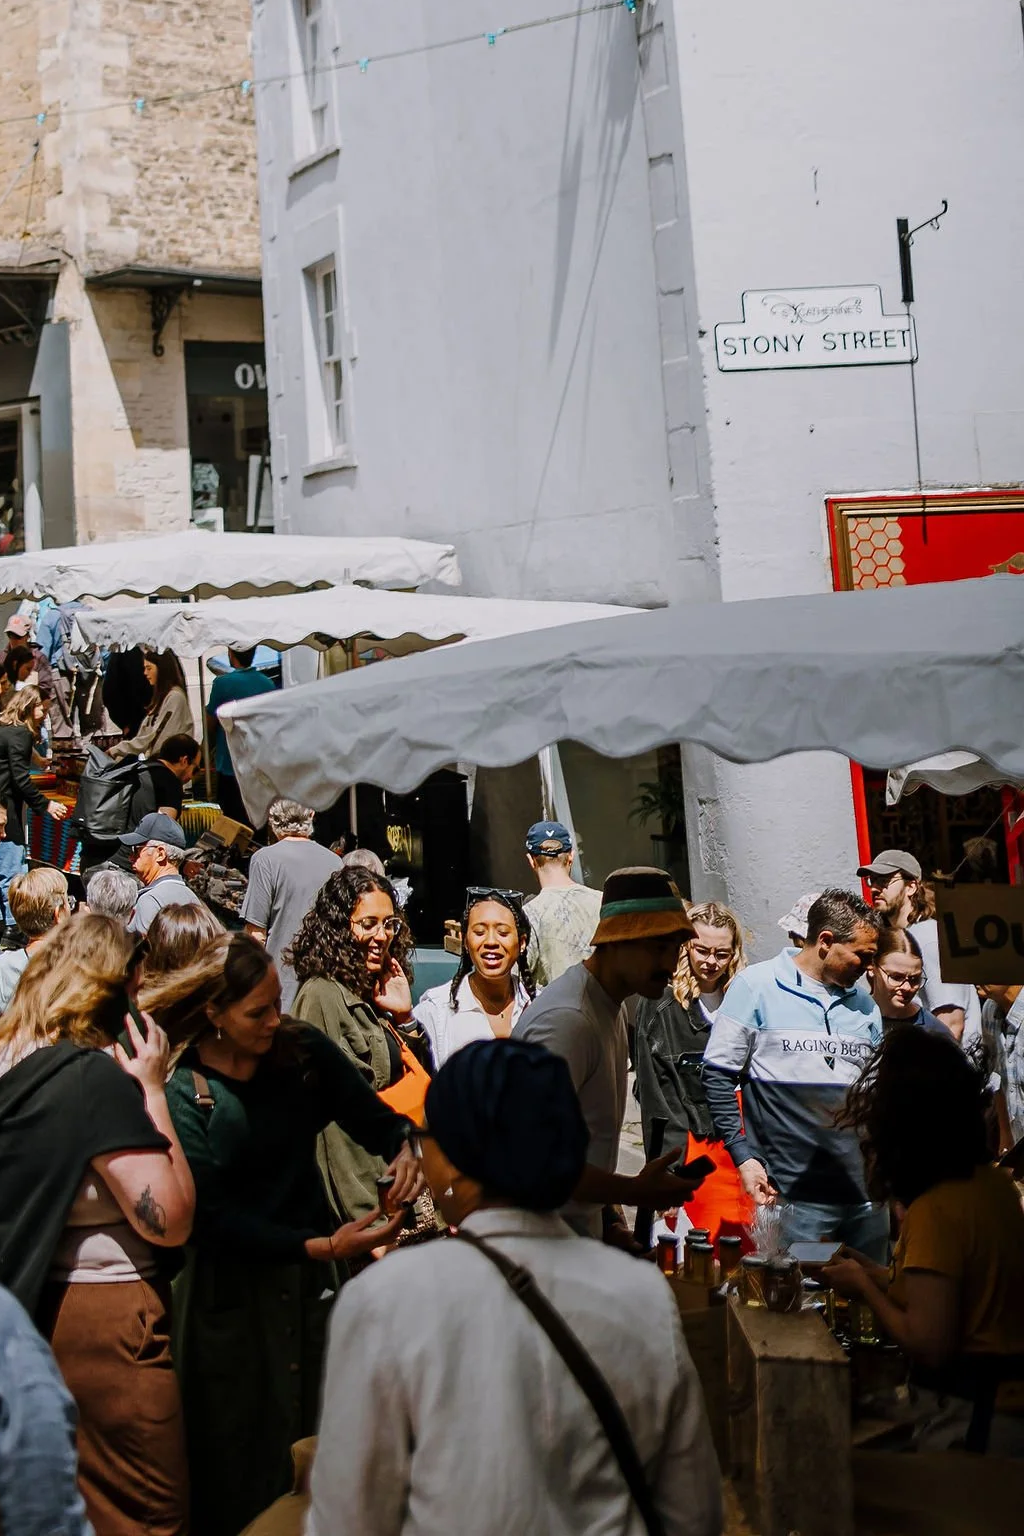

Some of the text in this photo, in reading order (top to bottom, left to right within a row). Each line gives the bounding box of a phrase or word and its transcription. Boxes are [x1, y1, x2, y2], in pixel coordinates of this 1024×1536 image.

[723, 329, 910, 356] STONY STREET
[782, 1039, 837, 1054] RAGING
